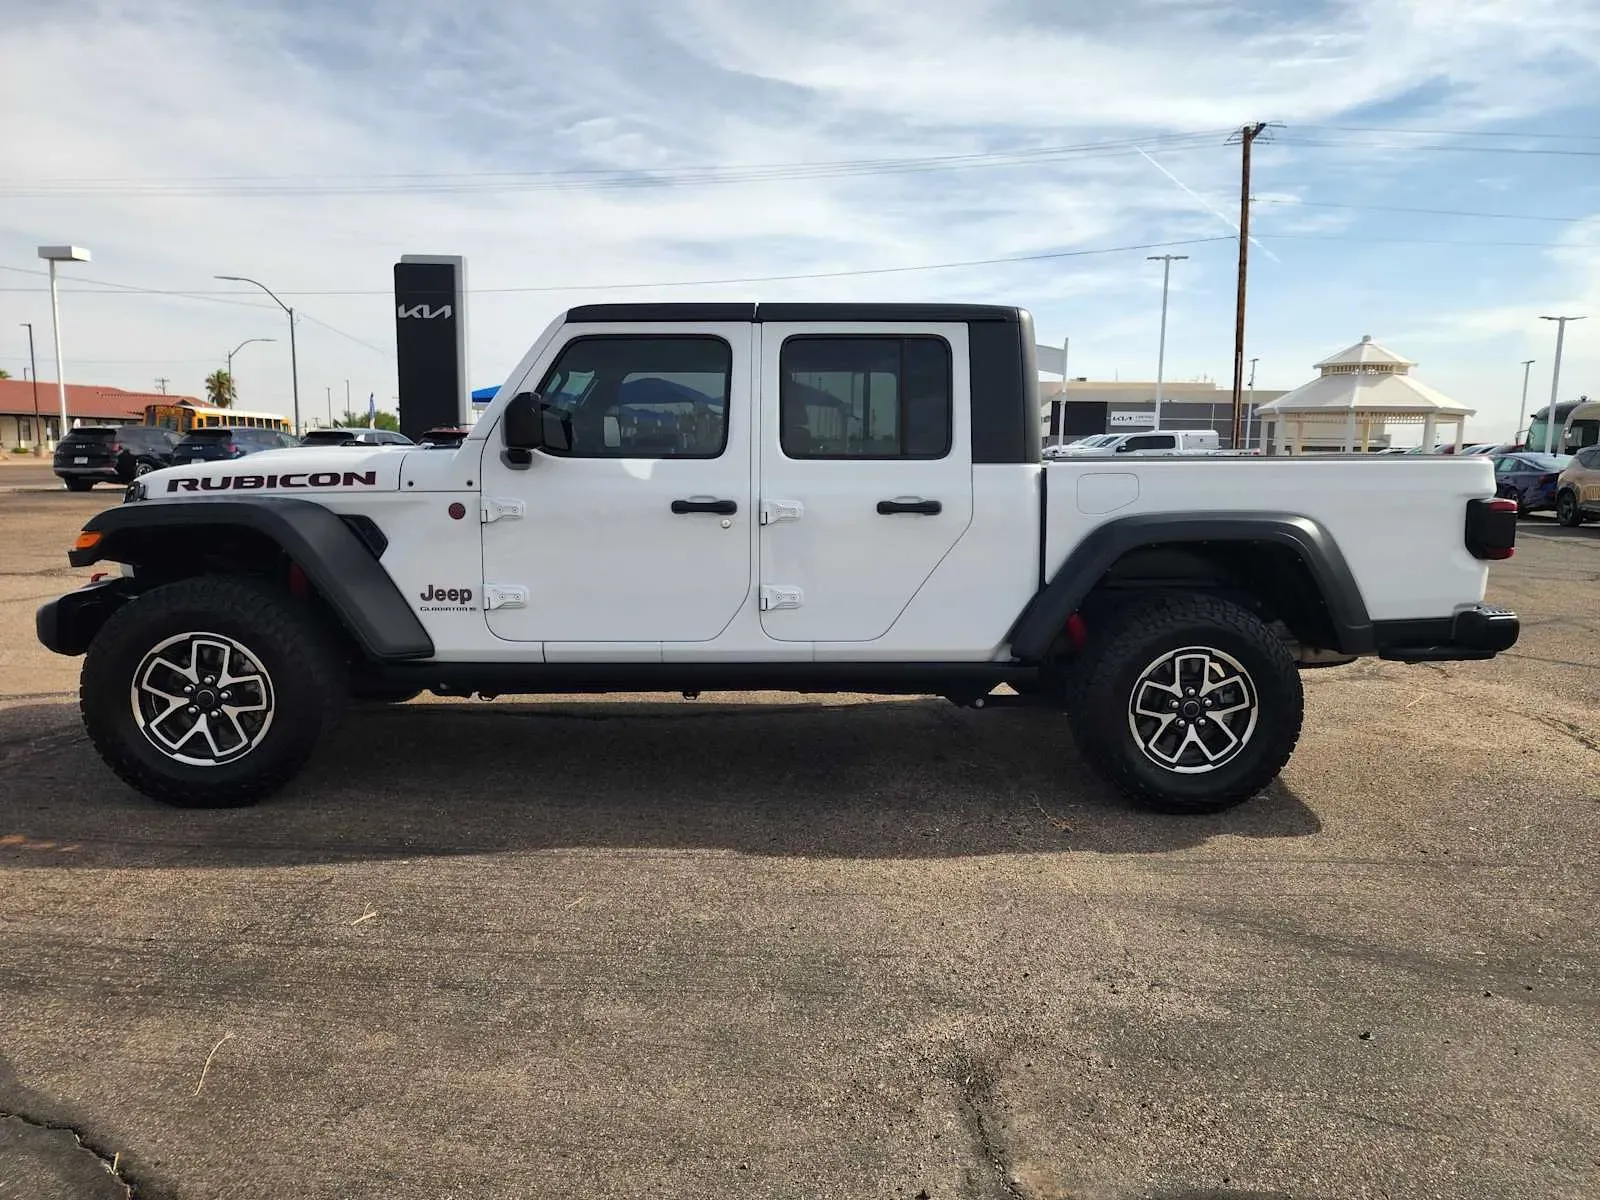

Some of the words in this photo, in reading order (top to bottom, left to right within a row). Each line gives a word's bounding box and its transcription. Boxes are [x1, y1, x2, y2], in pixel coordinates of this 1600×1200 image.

[398, 304, 452, 319] KIA
[167, 471, 377, 492] RUBICON
[420, 584, 472, 604] Jeep
